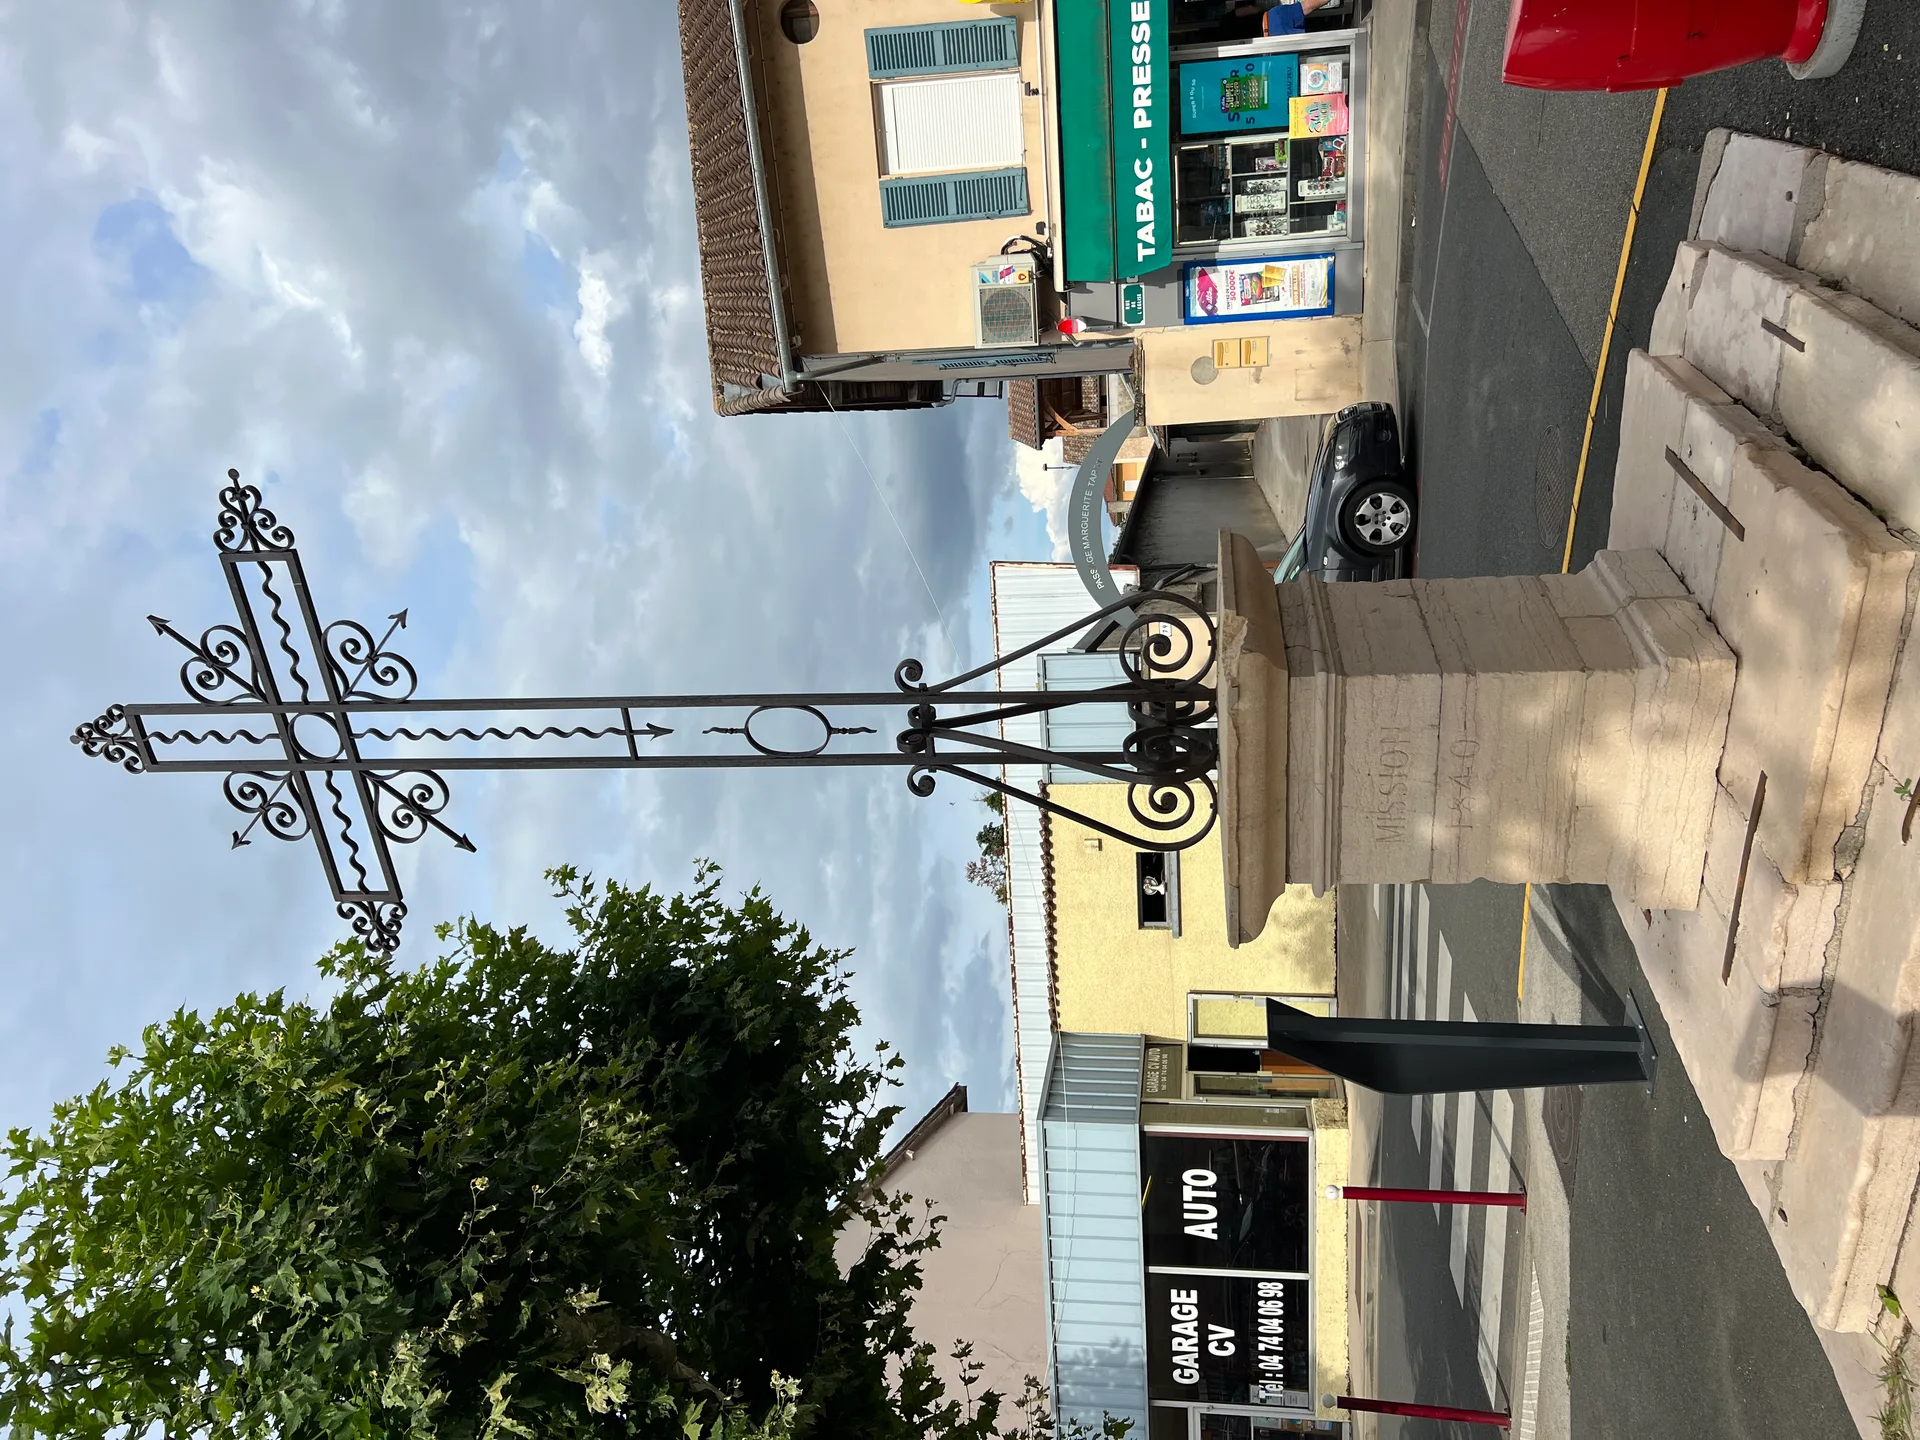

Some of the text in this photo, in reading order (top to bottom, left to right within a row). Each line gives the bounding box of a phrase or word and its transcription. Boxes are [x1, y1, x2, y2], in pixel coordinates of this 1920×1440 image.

[1130, 1, 1155, 262] TABAC - PRESSE
[1081, 490, 1093, 549] MARGUERITE
[1148, 1048, 1160, 1062] AUTO
[1146, 1071, 1159, 1092] GARAGE
[1182, 1168, 1218, 1240] AUTO
[1257, 1282, 1284, 1297] 98
[1258, 1300, 1284, 1316] 06
[1258, 1318, 1284, 1334] 04
[1170, 1288, 1200, 1384] GARAGE
[1208, 1324, 1236, 1357] CV
[1258, 1336, 1284, 1351] 74
[1258, 1355, 1284, 1370] 04
[1256, 1380, 1284, 1398] Tél
